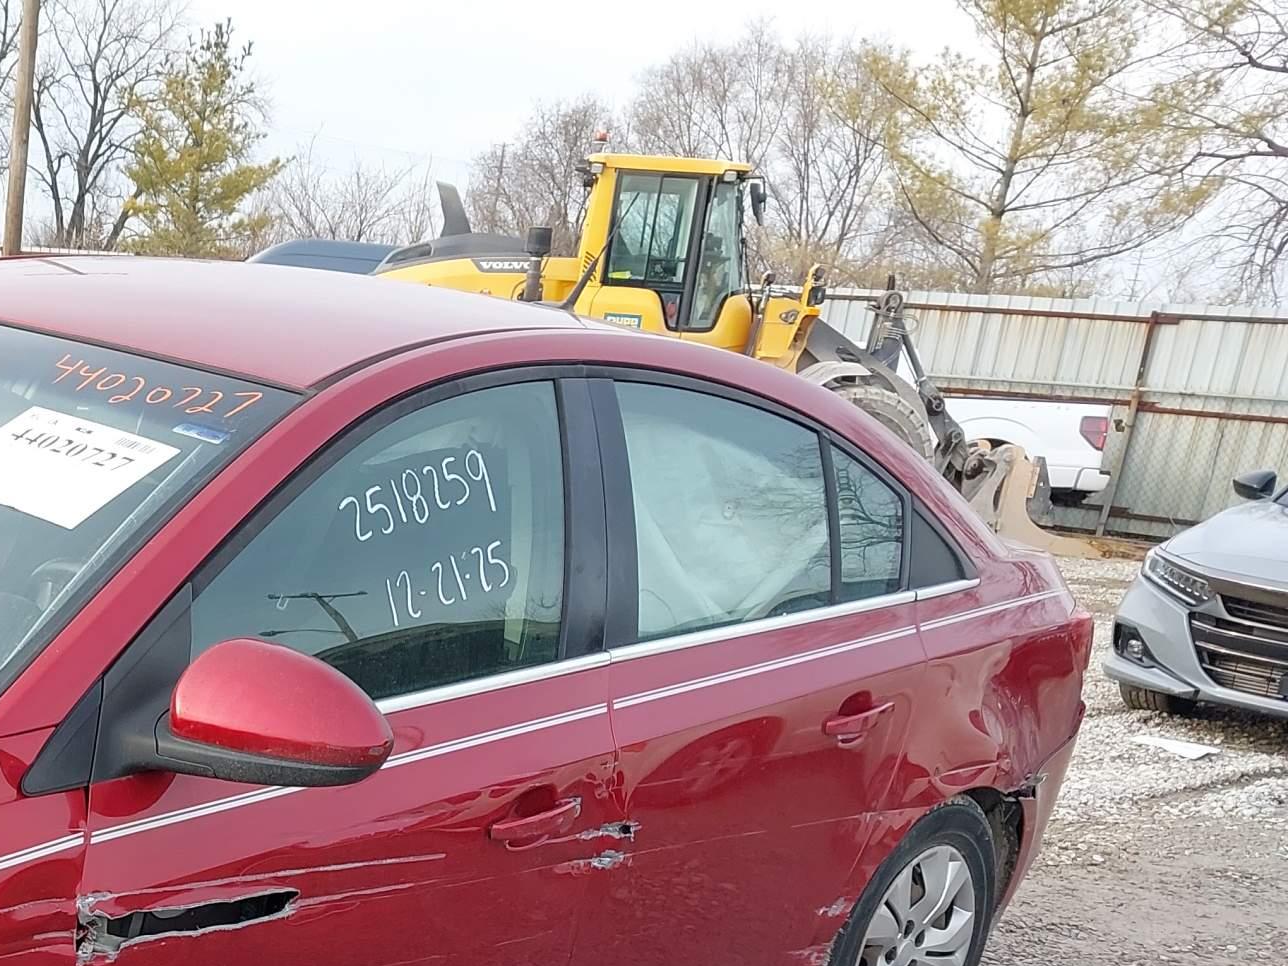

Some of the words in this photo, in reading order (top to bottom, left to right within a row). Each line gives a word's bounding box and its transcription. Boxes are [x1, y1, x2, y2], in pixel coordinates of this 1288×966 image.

[52, 353, 264, 418] 44020727
[11, 427, 136, 472] 44020727
[338, 449, 498, 542] 2518259
